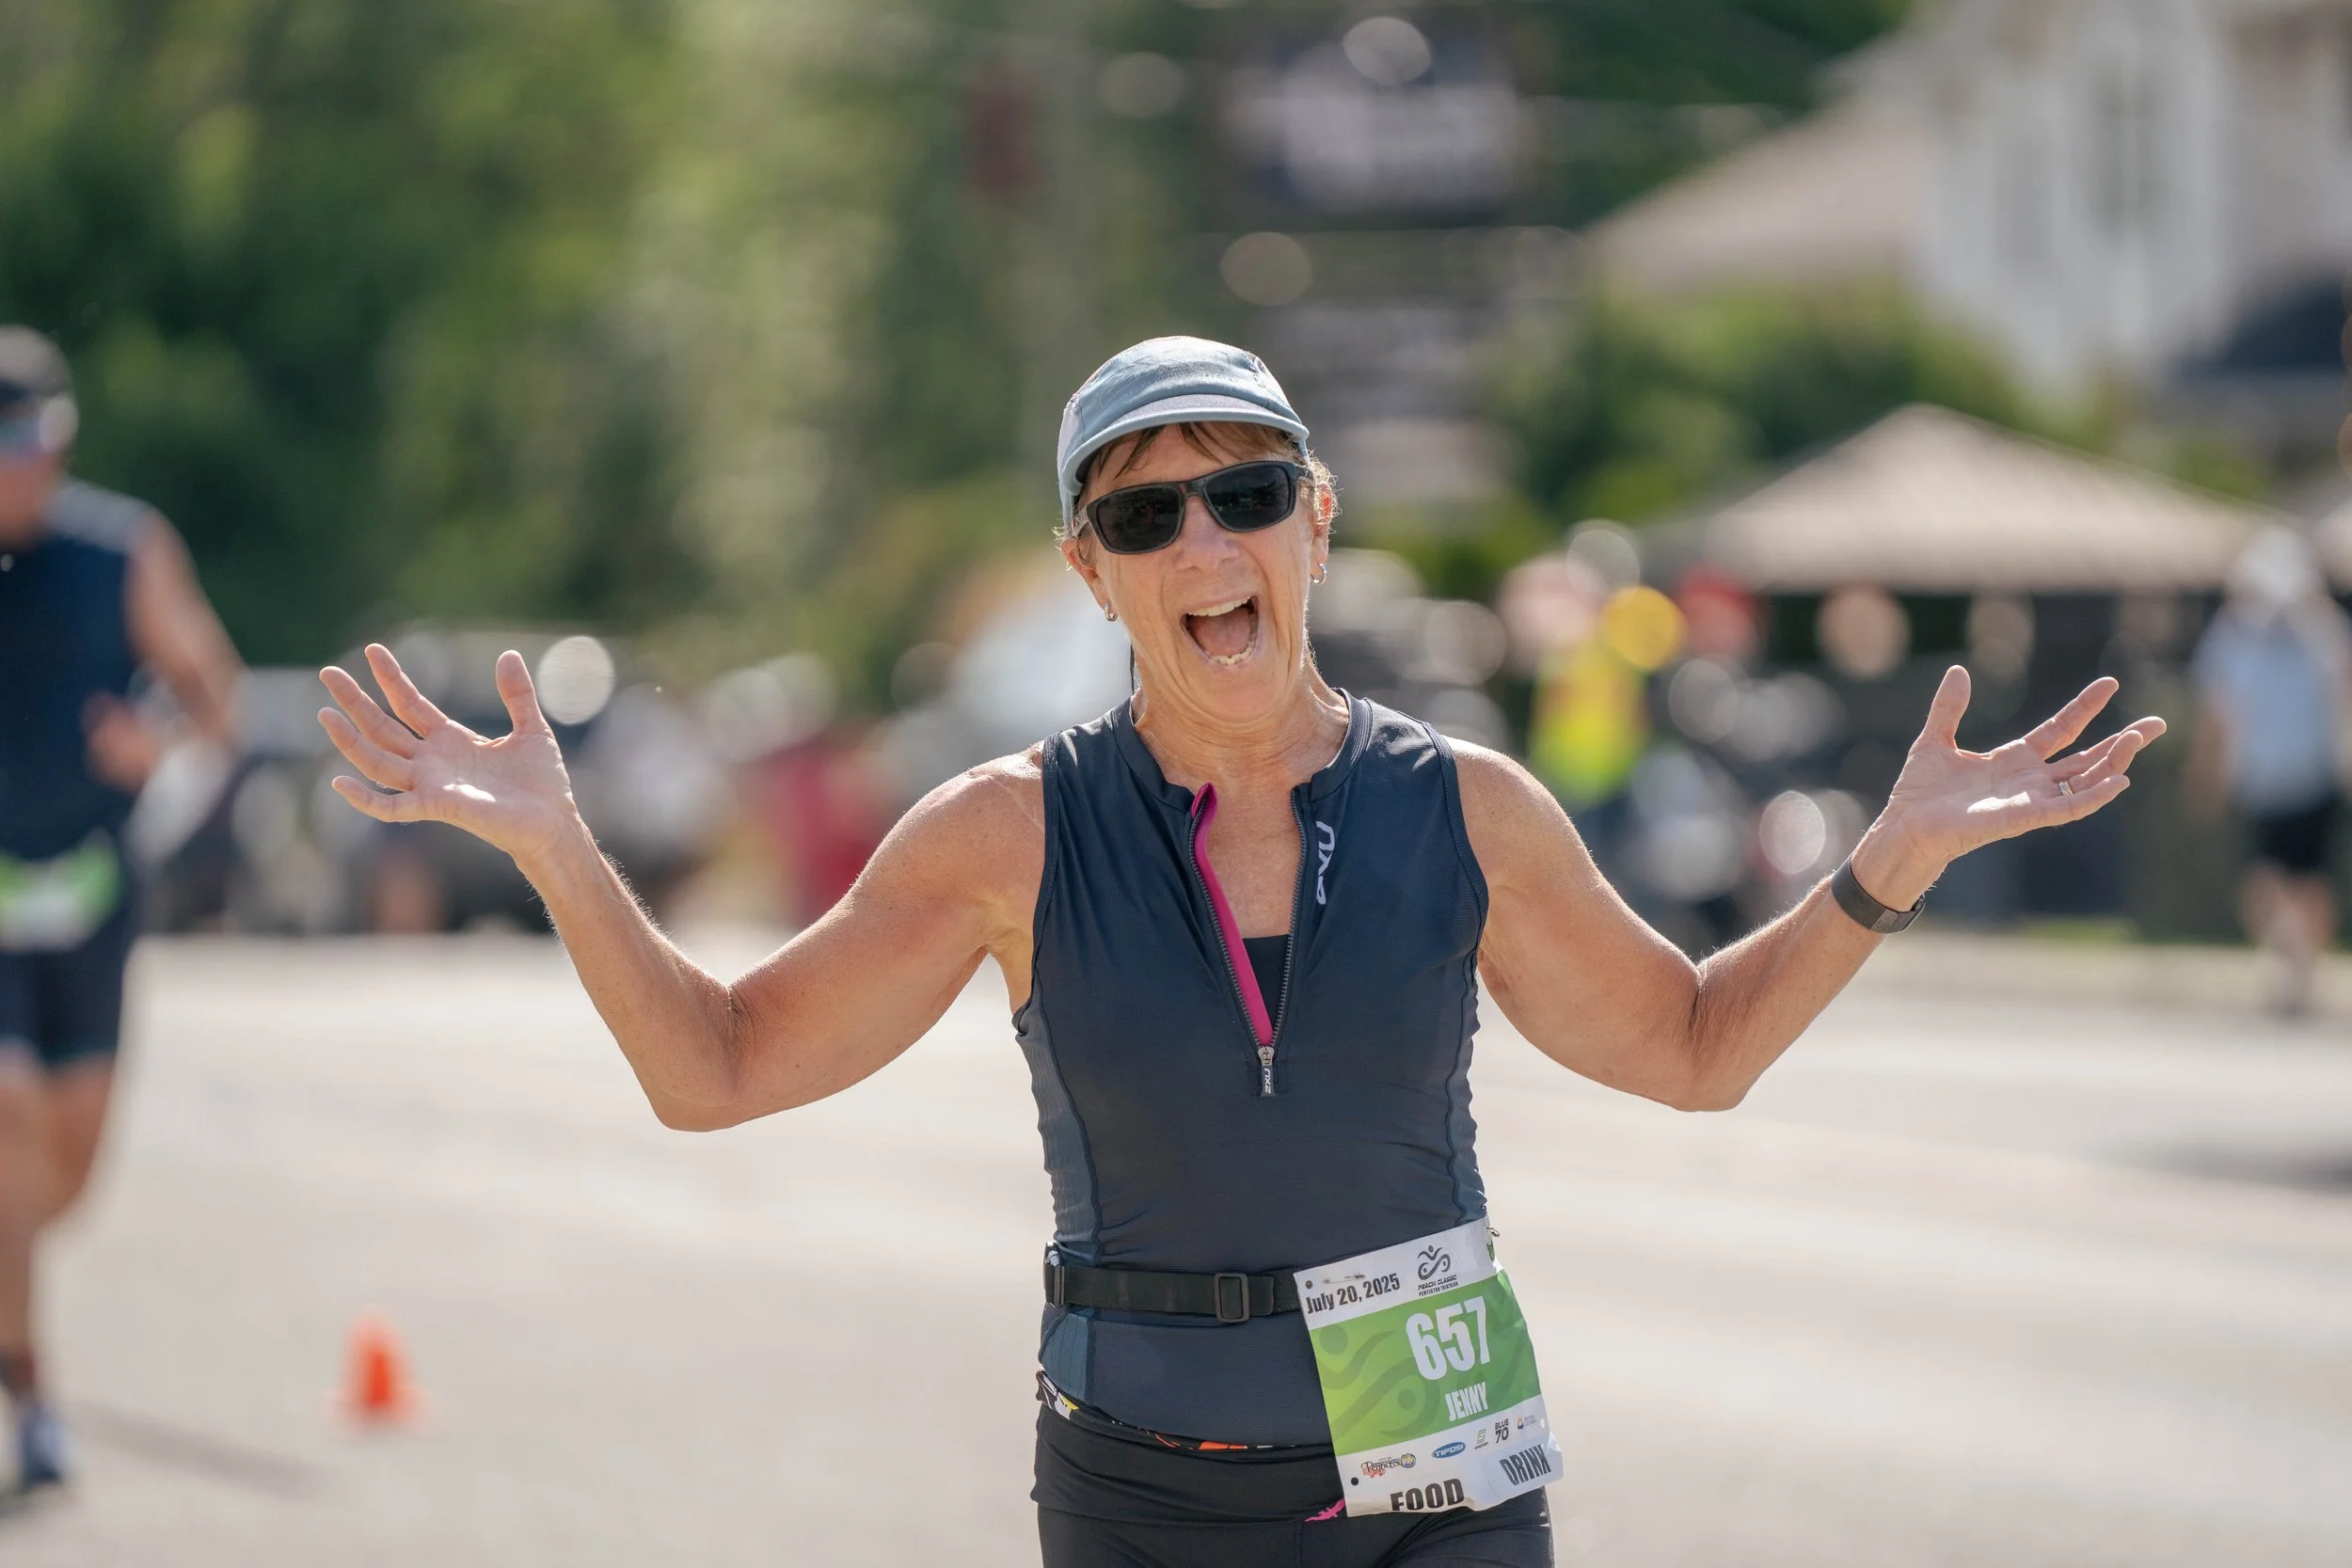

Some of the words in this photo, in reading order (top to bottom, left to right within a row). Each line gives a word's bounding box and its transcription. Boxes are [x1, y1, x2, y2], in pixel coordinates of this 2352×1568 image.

[1306, 1292, 1335, 1314] July
[1337, 1285, 1362, 1306] 20,
[1363, 1273, 1401, 1299] 2025
[1418, 1280, 1437, 1291] PEACH
[1437, 1274, 1457, 1285] CLASSIC
[1406, 1296, 1490, 1380] 657
[1445, 1382, 1488, 1422] JENNY
[1495, 1418, 1509, 1430] BLUE
[1495, 1427, 1509, 1444] 70
[1434, 1444, 1464, 1457] TIFOSI
[1499, 1445, 1551, 1486] DRINK
[1390, 1478, 1465, 1511] FOOD
